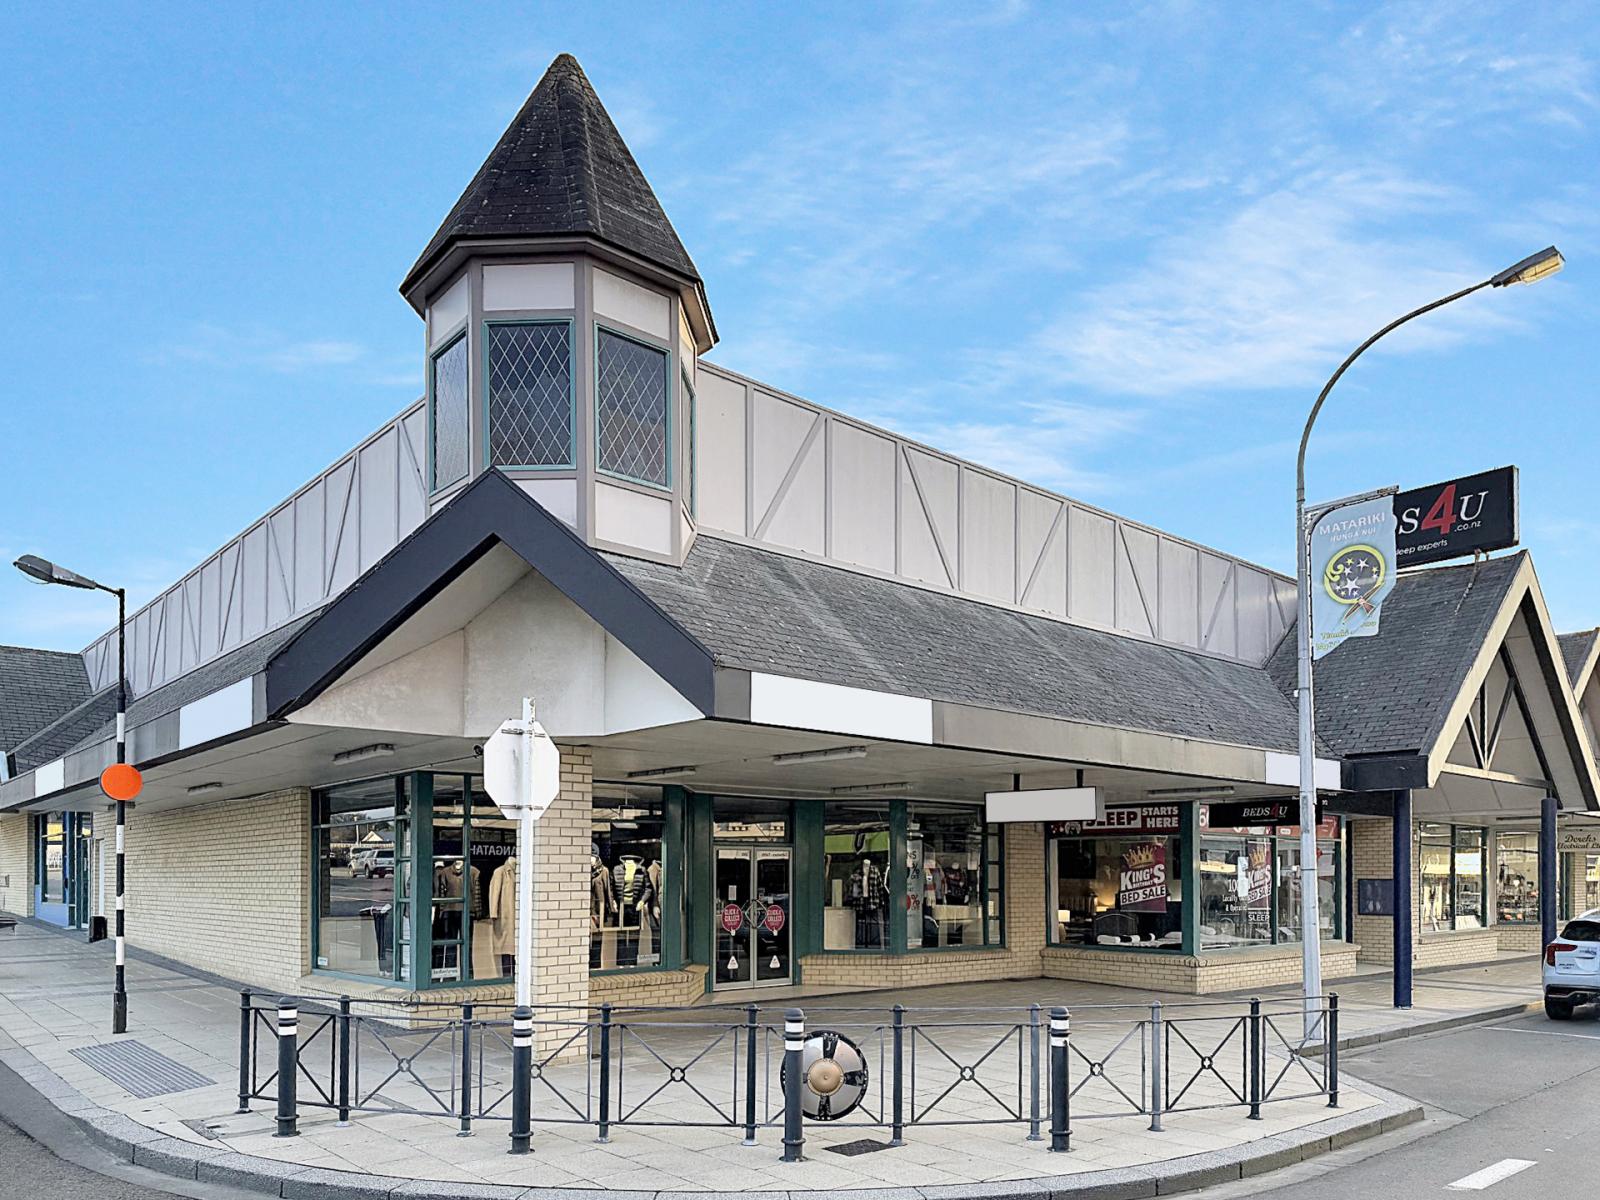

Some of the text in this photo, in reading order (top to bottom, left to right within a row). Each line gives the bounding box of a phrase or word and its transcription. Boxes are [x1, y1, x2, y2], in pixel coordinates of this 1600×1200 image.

[1399, 484, 1489, 535] S4U
[1320, 512, 1385, 535] MATARIKI
[1454, 521, 1481, 532] .co.nz
[1396, 539, 1448, 556] leep experts
[1142, 806, 1179, 816] STARTS
[1242, 803, 1288, 817] BEDS4U
[1146, 817, 1179, 828] HERE
[1120, 864, 1166, 891] KING'S
[1121, 886, 1166, 904] BED SALE
[1247, 914, 1269, 922] SLEEP
